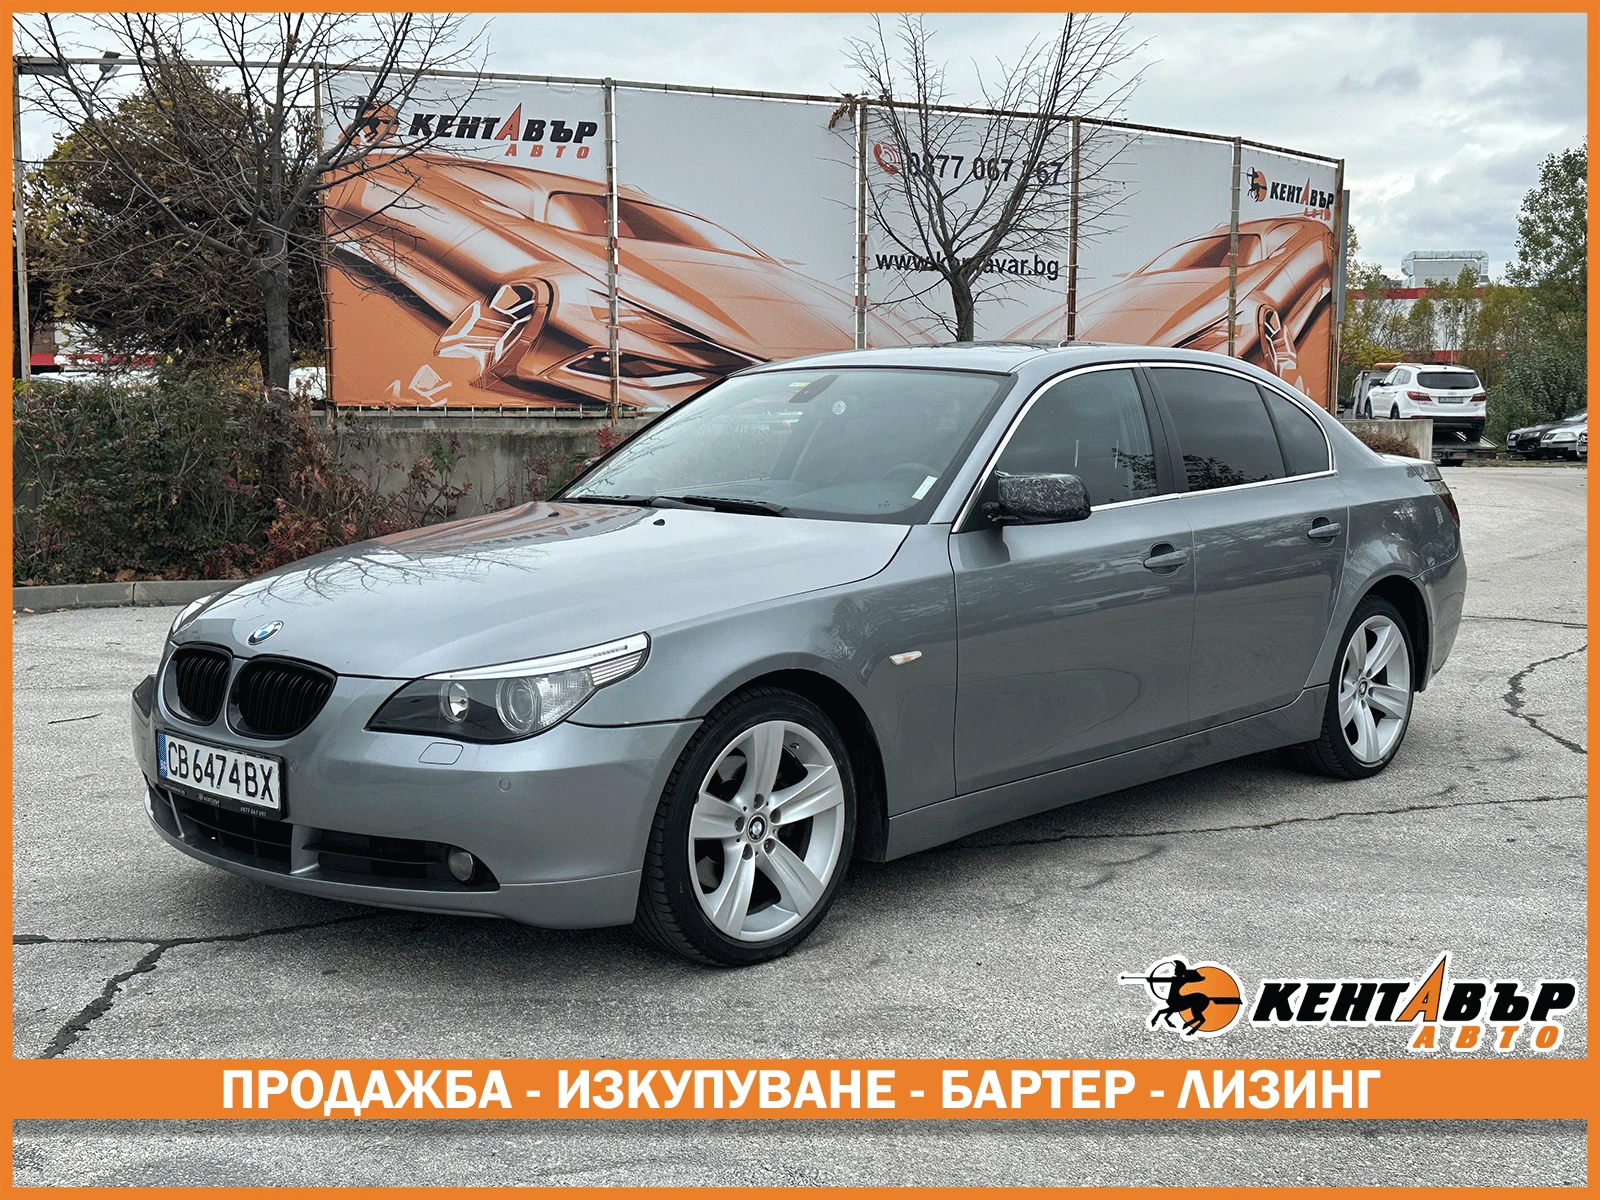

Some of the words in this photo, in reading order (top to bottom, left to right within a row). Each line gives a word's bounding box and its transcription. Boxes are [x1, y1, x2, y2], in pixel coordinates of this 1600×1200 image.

[408, 103, 598, 144] КЕНТАВЪР
[505, 144, 590, 158] АВТО
[908, 152, 964, 179] 0877
[972, 156, 1014, 182] 067
[1022, 159, 1064, 187] 67
[1270, 177, 1334, 209] КЕНТАВЪР
